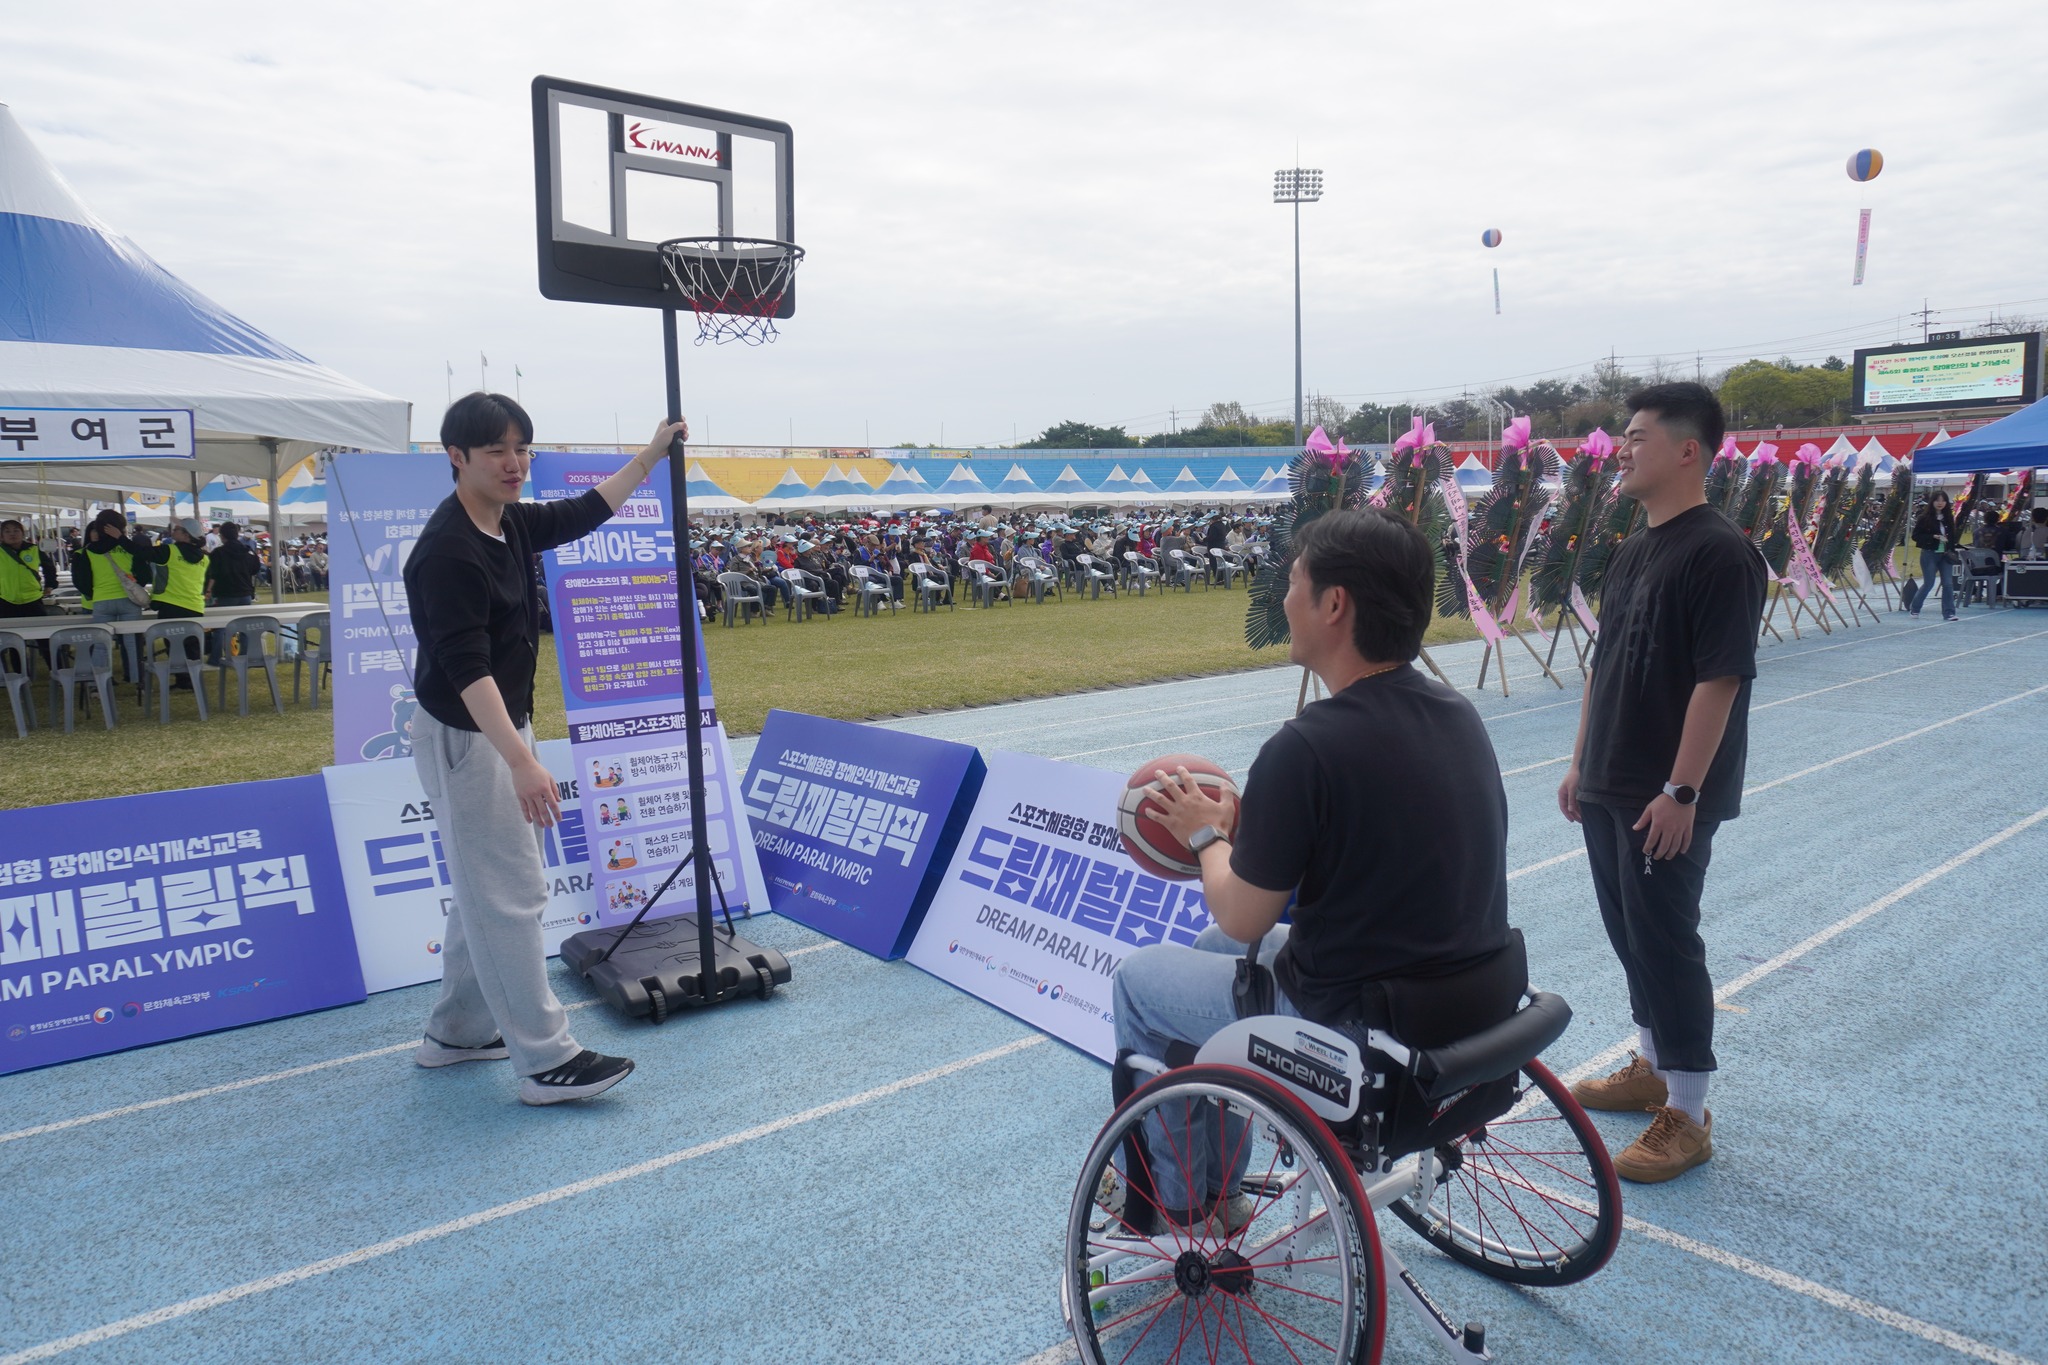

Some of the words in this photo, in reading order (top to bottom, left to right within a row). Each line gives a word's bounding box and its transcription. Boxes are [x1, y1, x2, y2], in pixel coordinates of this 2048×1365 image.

[1931, 332, 1956, 341] 10:35
[1, 417, 175, 451] 부여군
[568, 475, 590, 484] 2026
[637, 504, 660, 518] 안내
[564, 576, 620, 588] 장애인스포츠의
[572, 606, 594, 614] 장애가
[594, 605, 608, 613] 있는
[629, 752, 670, 768] 휠체어농구
[630, 767, 648, 778] 방식
[649, 762, 682, 775] 이해하기
[778, 748, 836, 776] 스포츠체험형
[834, 761, 921, 799] 장애인식개선교육
[638, 794, 662, 807] 휠체어
[664, 791, 680, 802] 주행
[640, 808, 656, 818] 전환
[657, 802, 690, 816] 연습하기
[746, 768, 930, 868] 드림패럴림픽
[1008, 802, 1090, 842] 스포츠체험형
[644, 834, 669, 846] 패스와
[48, 828, 263, 880] 장애인식개선교육
[646, 844, 679, 859] 연습하기
[754, 830, 792, 858] DREAM
[792, 844, 873, 886] PARALYMPIC
[678, 877, 694, 888] 게임
[976, 904, 1036, 944] DREAM
[41, 938, 256, 995] PARALYMPIC
[143, 991, 211, 1012] 문화체육관광부
[1061, 991, 1101, 1016] 문화체육관광부
